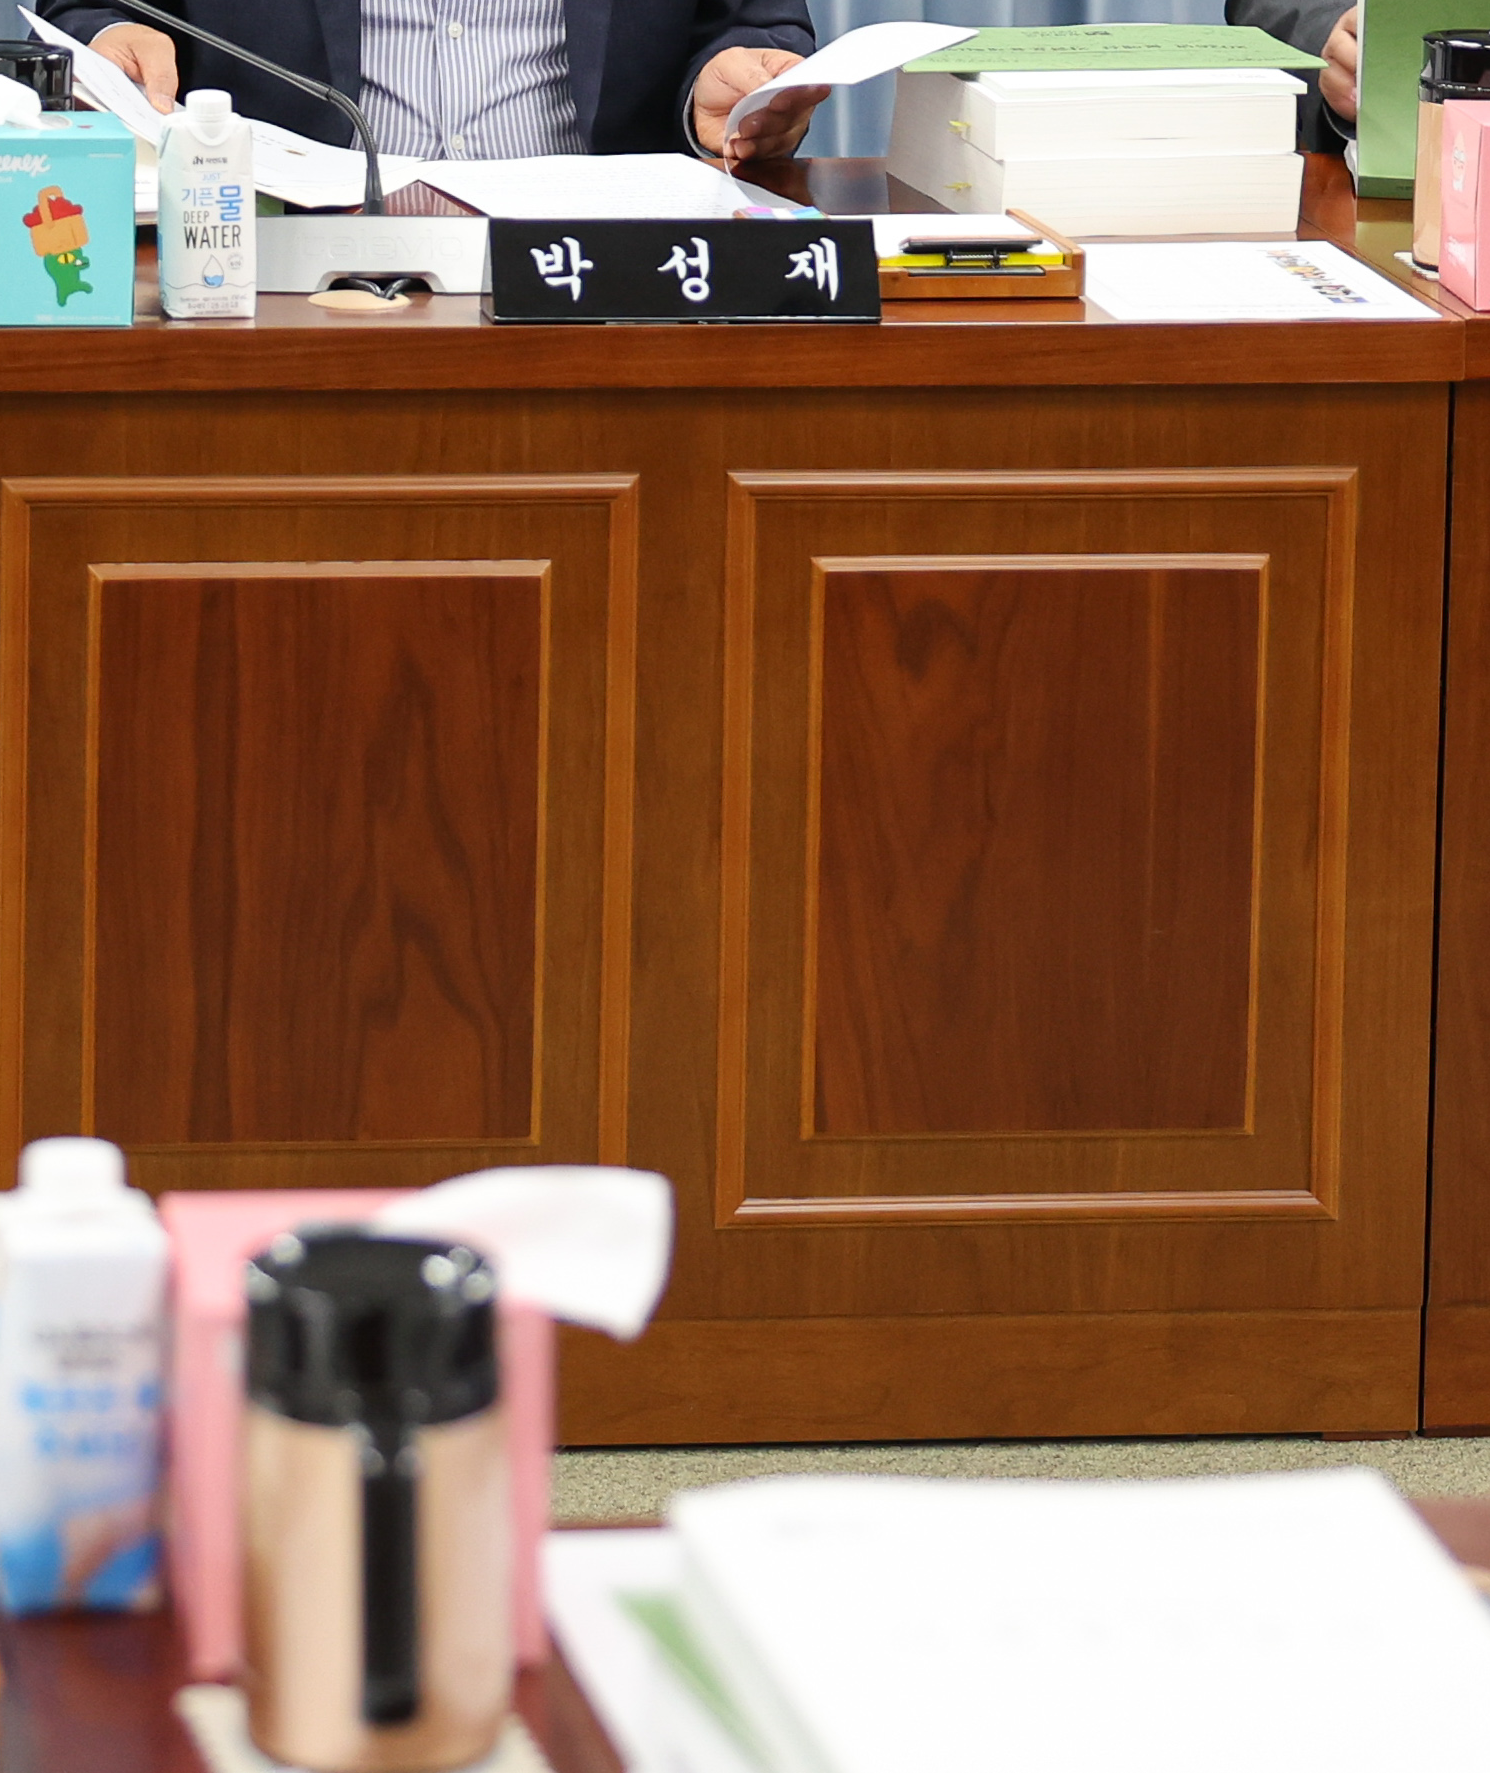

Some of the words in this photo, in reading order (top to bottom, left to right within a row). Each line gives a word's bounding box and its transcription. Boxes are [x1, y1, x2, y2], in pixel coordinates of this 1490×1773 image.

[183, 210, 210, 224] DEEP
[184, 225, 242, 249] WATER
[529, 236, 840, 302] 박성재
